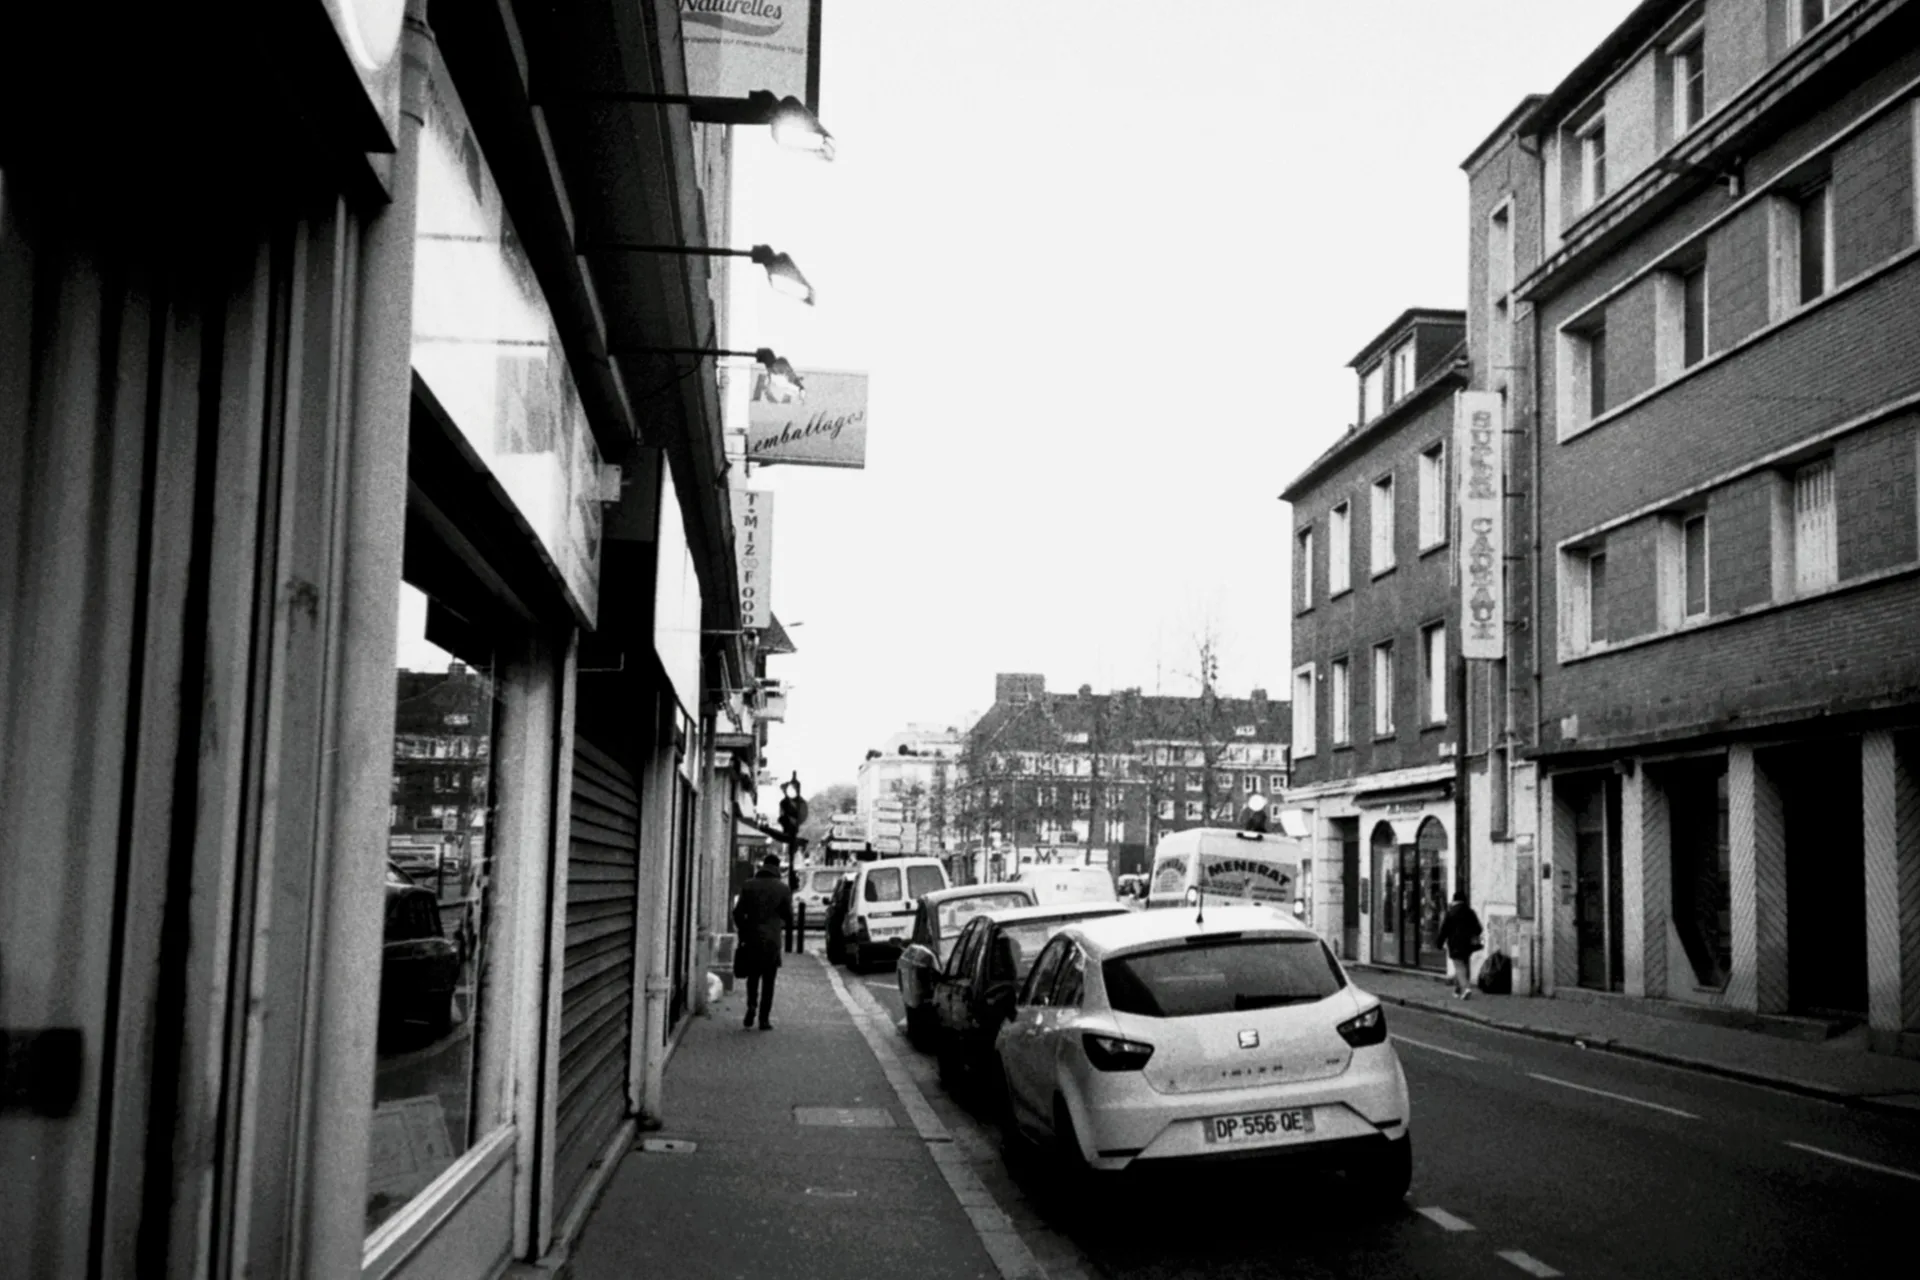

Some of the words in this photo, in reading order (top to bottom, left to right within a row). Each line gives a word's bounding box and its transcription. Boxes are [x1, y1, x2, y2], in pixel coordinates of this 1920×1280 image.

[681, 0, 782, 19] Naturelles
[754, 410, 864, 453] emballages
[742, 570, 755, 625] FOOD
[1207, 859, 1291, 886] MENERAT
